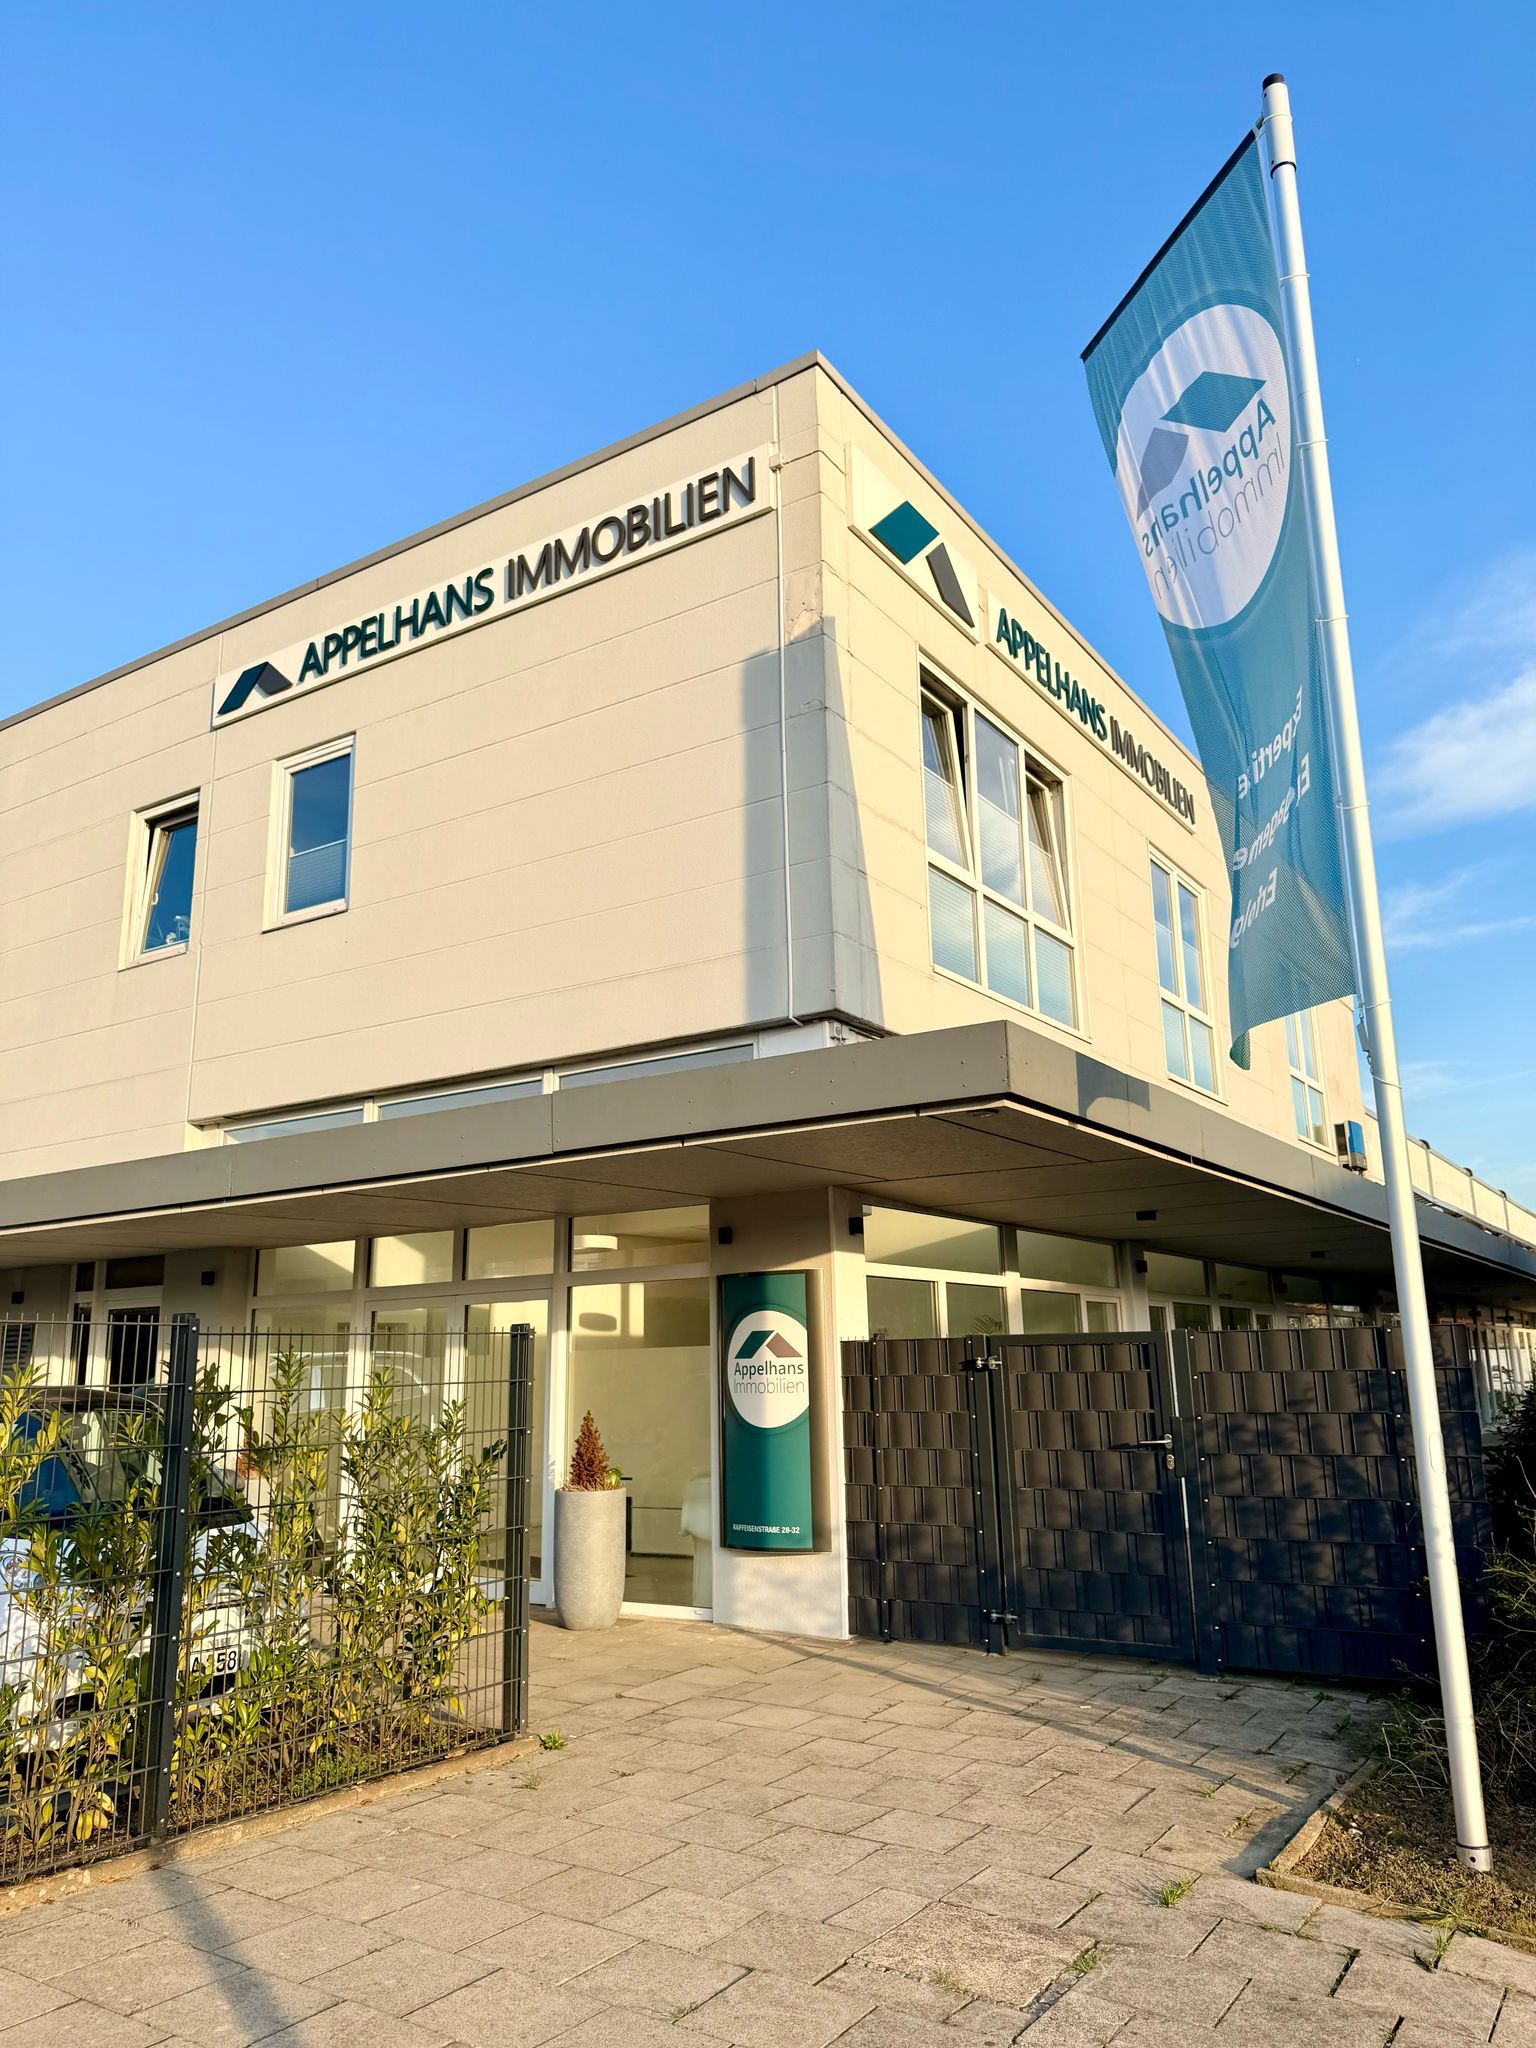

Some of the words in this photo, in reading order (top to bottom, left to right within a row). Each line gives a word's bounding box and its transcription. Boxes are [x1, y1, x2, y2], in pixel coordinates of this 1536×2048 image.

[298, 567, 495, 682] APPELHANS
[507, 456, 756, 600] IMMOBILIEN
[995, 607, 1108, 742] APPELHANS
[1109, 715, 1196, 825] IMMOBILIEN
[734, 1360, 804, 1380] Appelhans
[733, 1377, 805, 1394] Immobilien
[781, 1526, 800, 1534] 28-32
